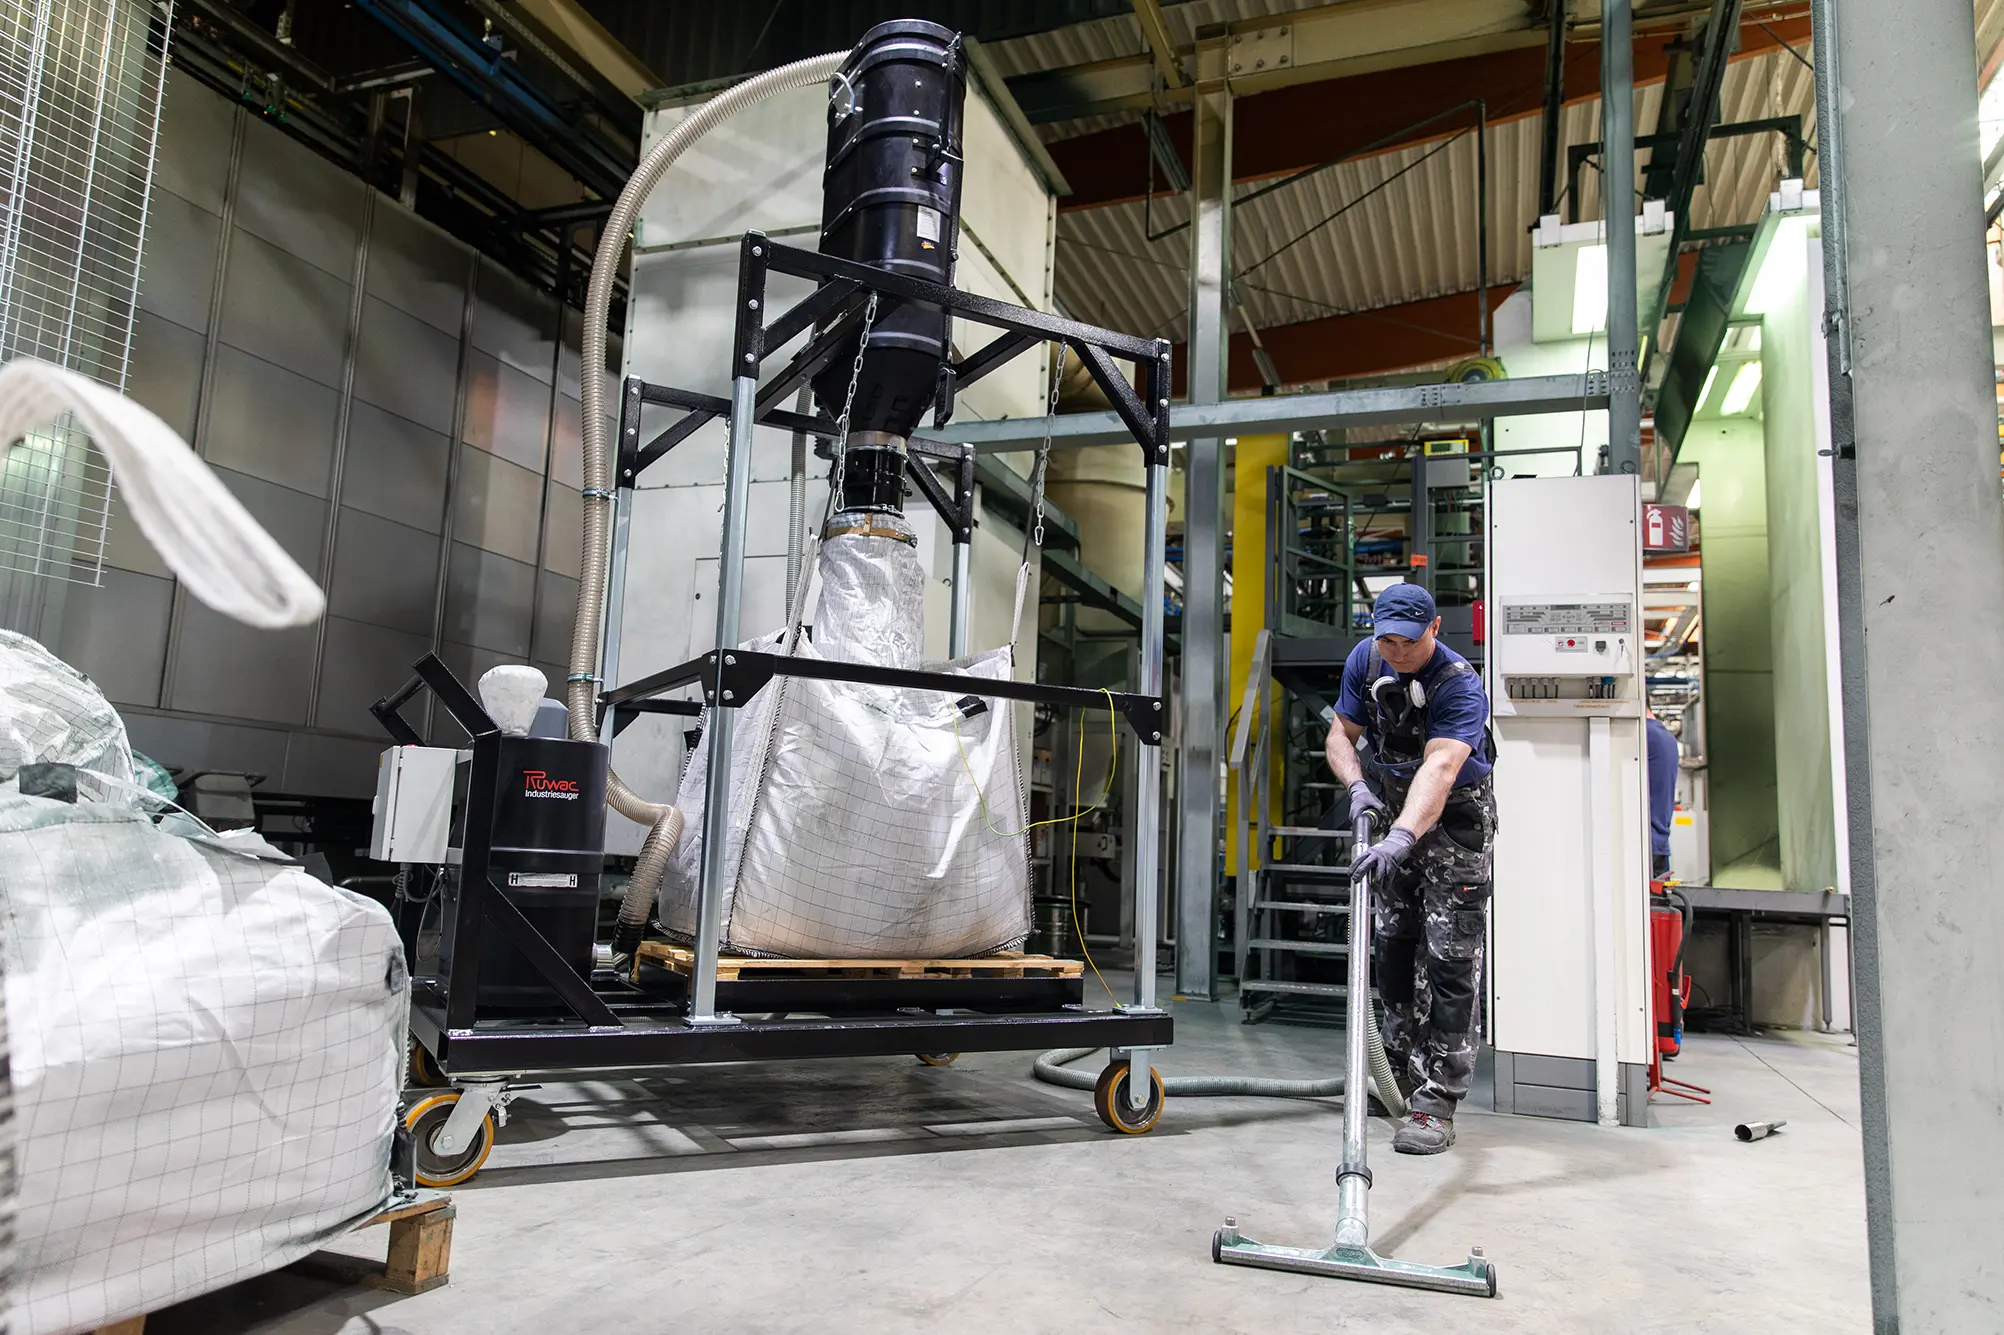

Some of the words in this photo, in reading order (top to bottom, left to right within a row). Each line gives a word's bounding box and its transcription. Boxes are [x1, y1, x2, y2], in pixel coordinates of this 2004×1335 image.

[523, 770, 579, 791] Ruwac
[510, 873, 519, 885] H
[569, 875, 576, 886] H
